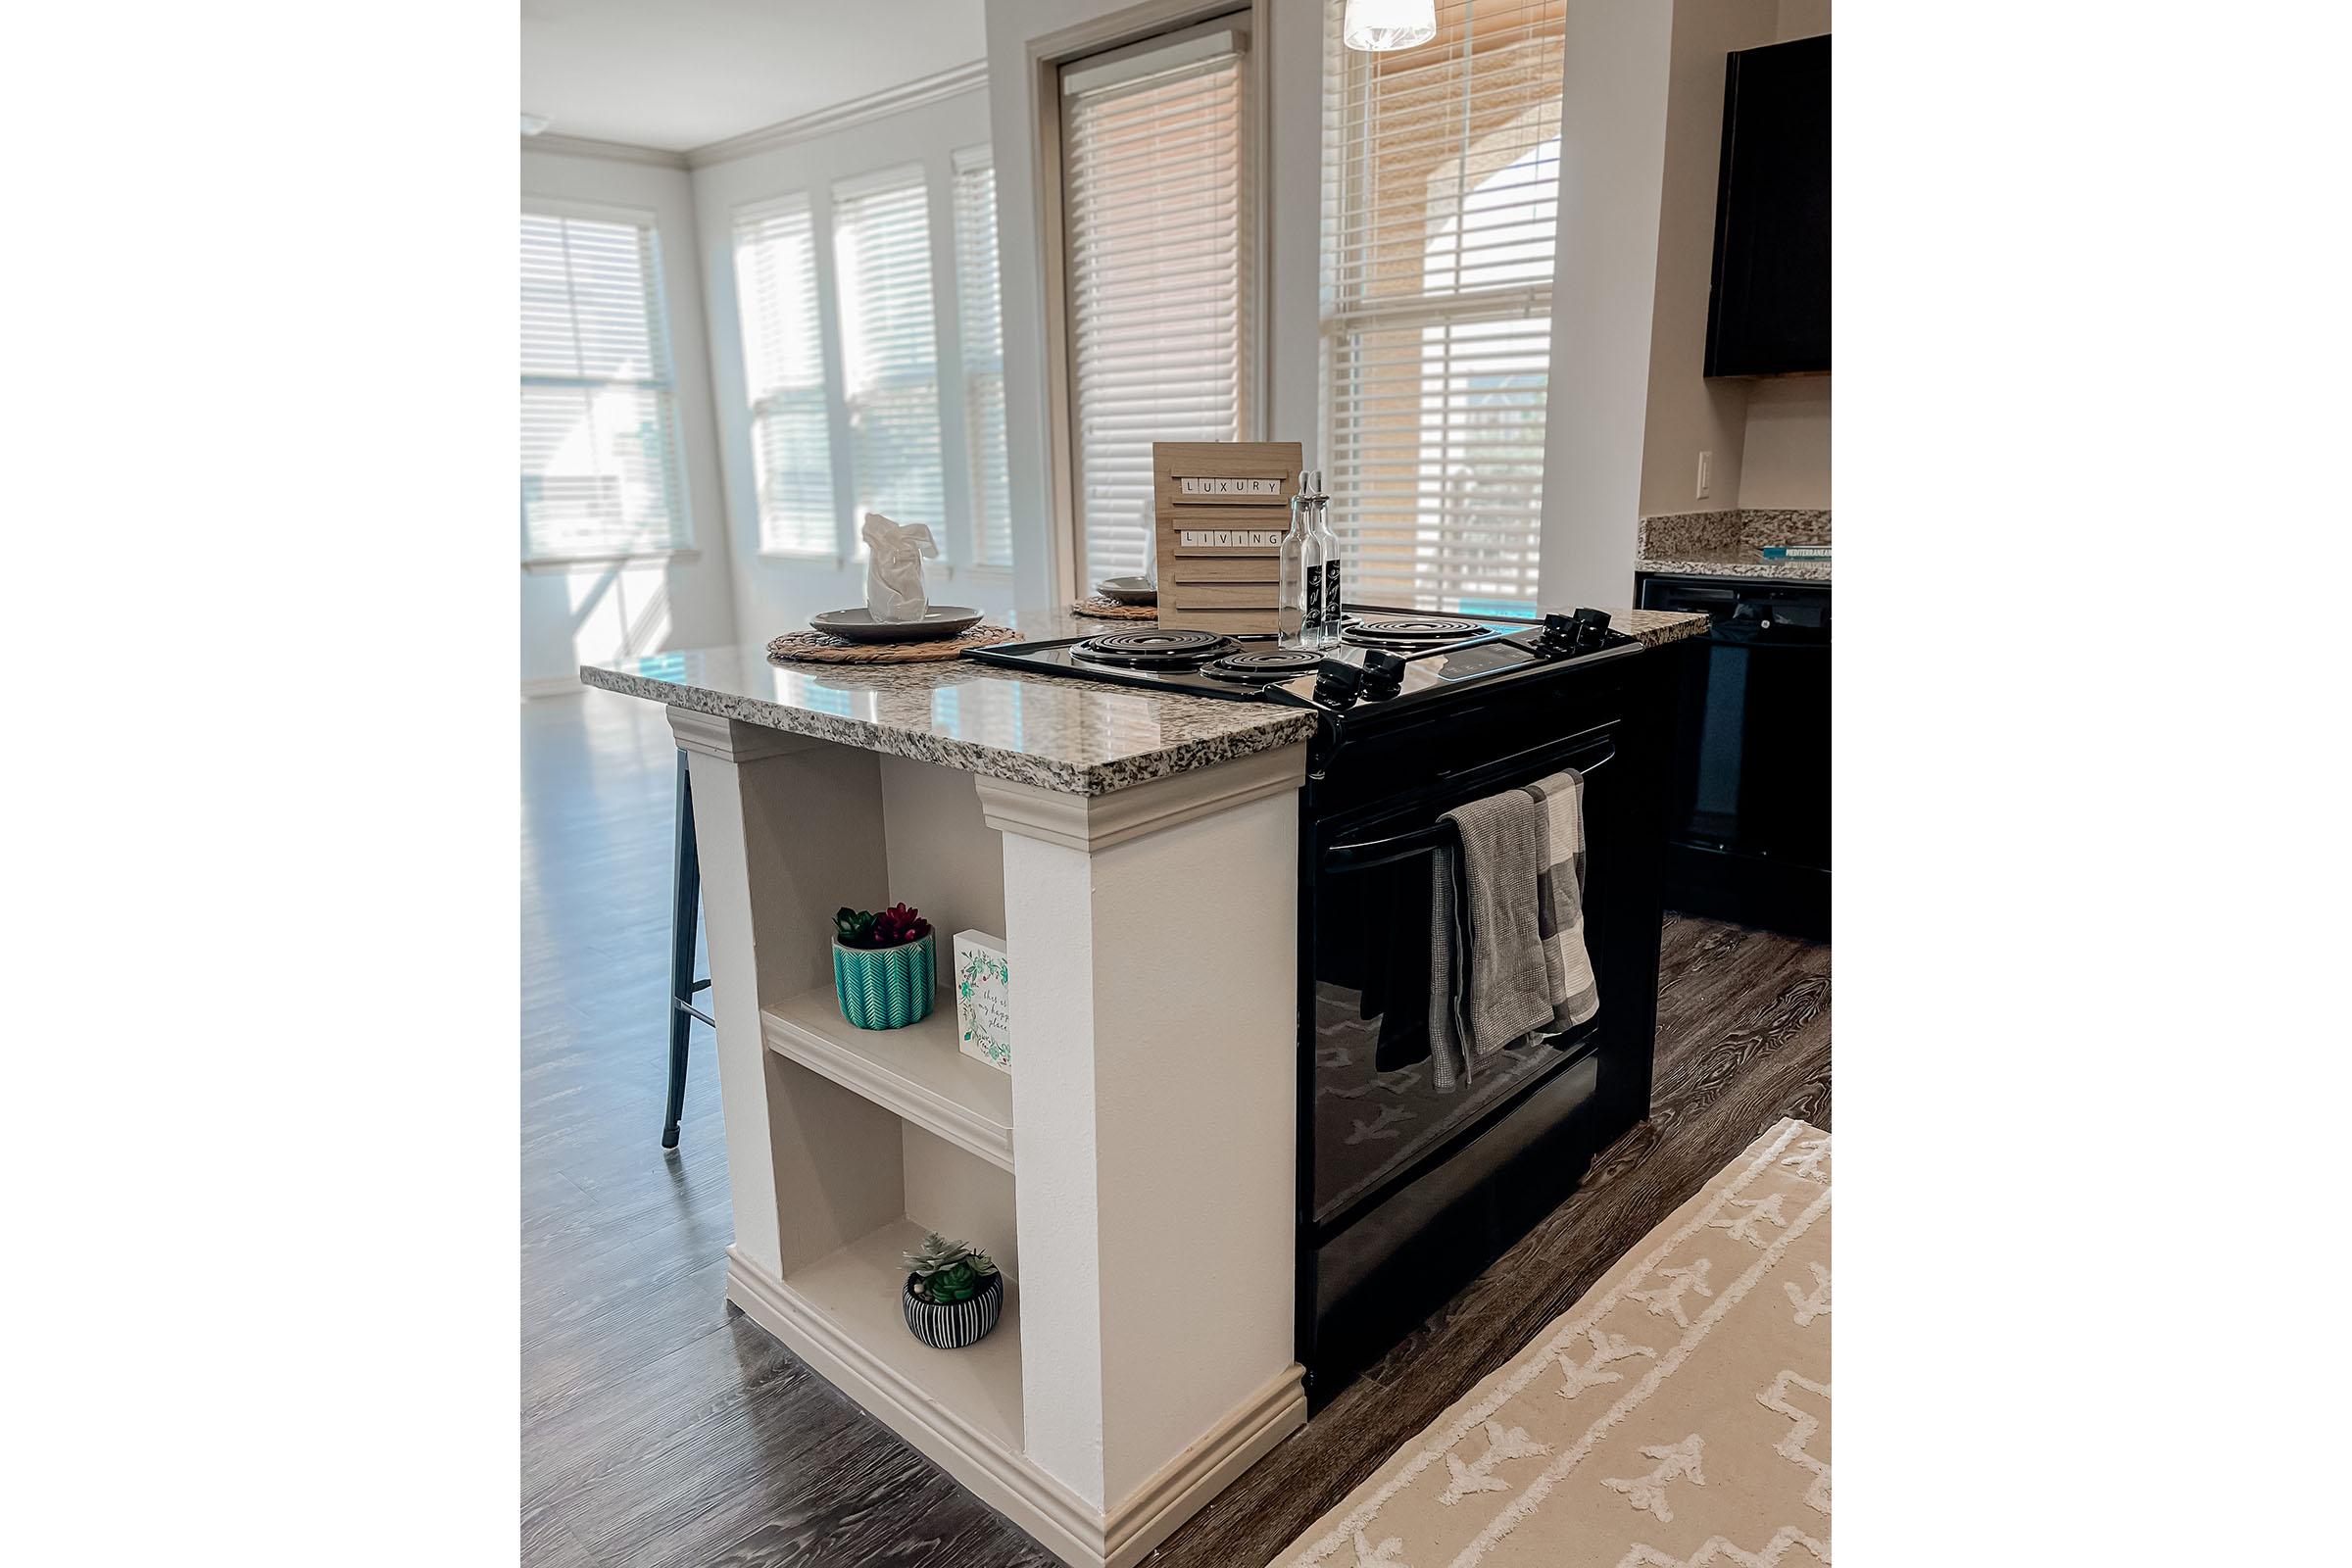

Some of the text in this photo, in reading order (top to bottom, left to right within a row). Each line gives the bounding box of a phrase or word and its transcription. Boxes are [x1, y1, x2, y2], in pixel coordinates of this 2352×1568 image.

[1187, 480, 1276, 493] LUXURY
[1186, 531, 1277, 545] LIVING
[991, 1003, 1009, 1023] happ
